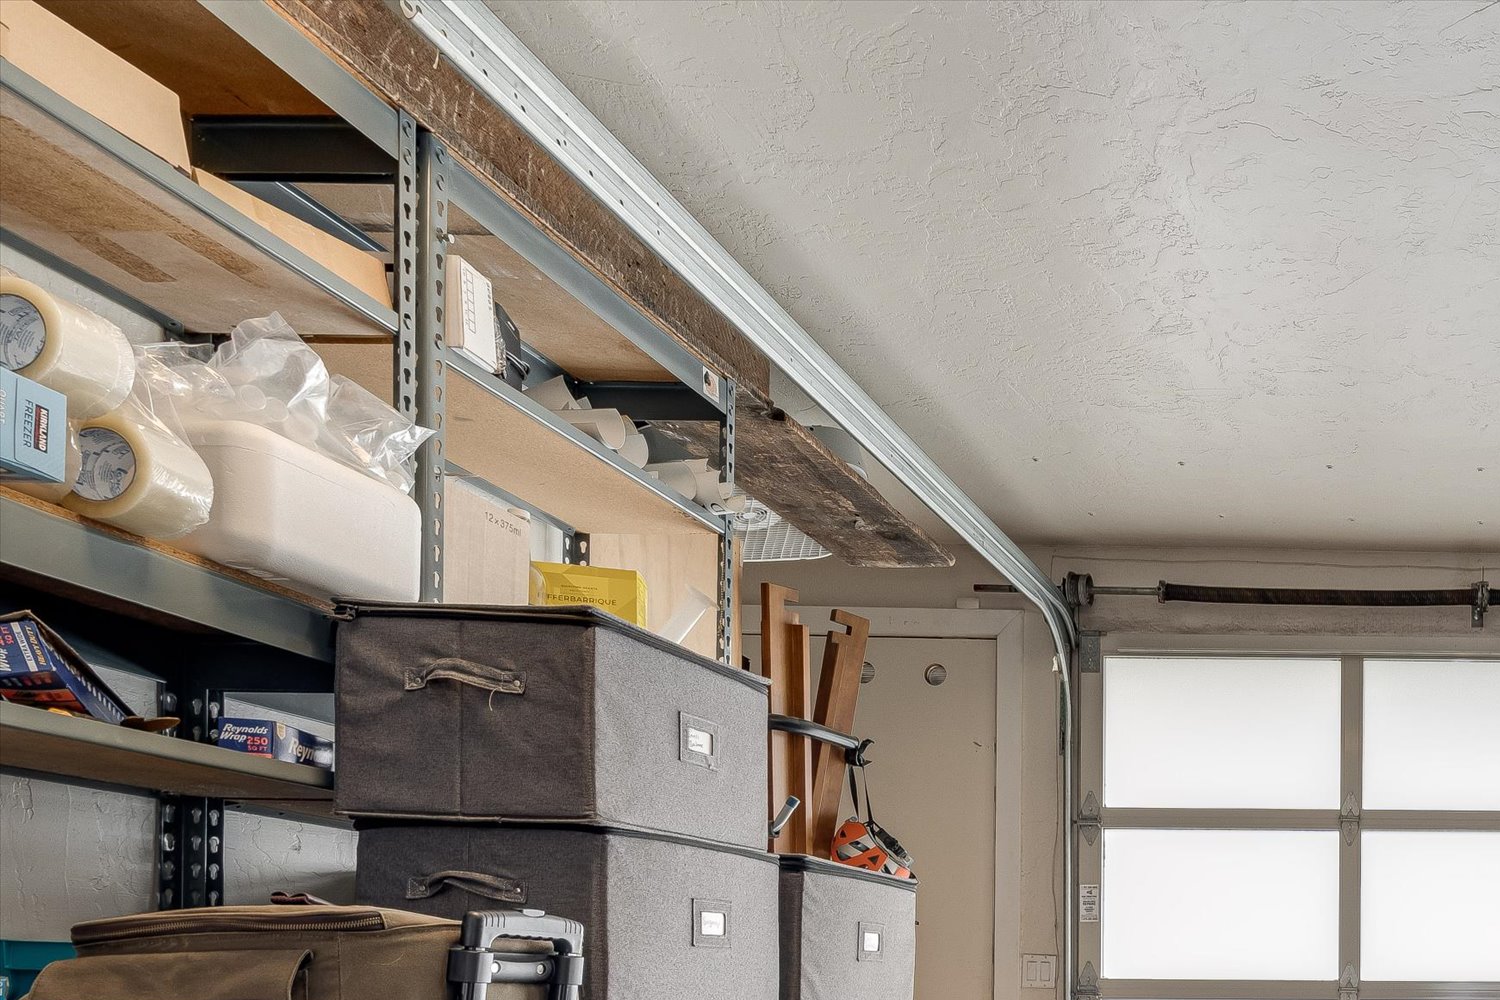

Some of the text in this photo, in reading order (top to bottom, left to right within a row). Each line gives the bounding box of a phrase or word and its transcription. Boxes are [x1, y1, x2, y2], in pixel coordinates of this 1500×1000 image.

[22, 399, 34, 448] FREEZER
[38, 408, 49, 452] KIRKLAND
[222, 723, 268, 735] Reynolds
[220, 732, 247, 743] Wrap
[247, 736, 268, 745] 250
